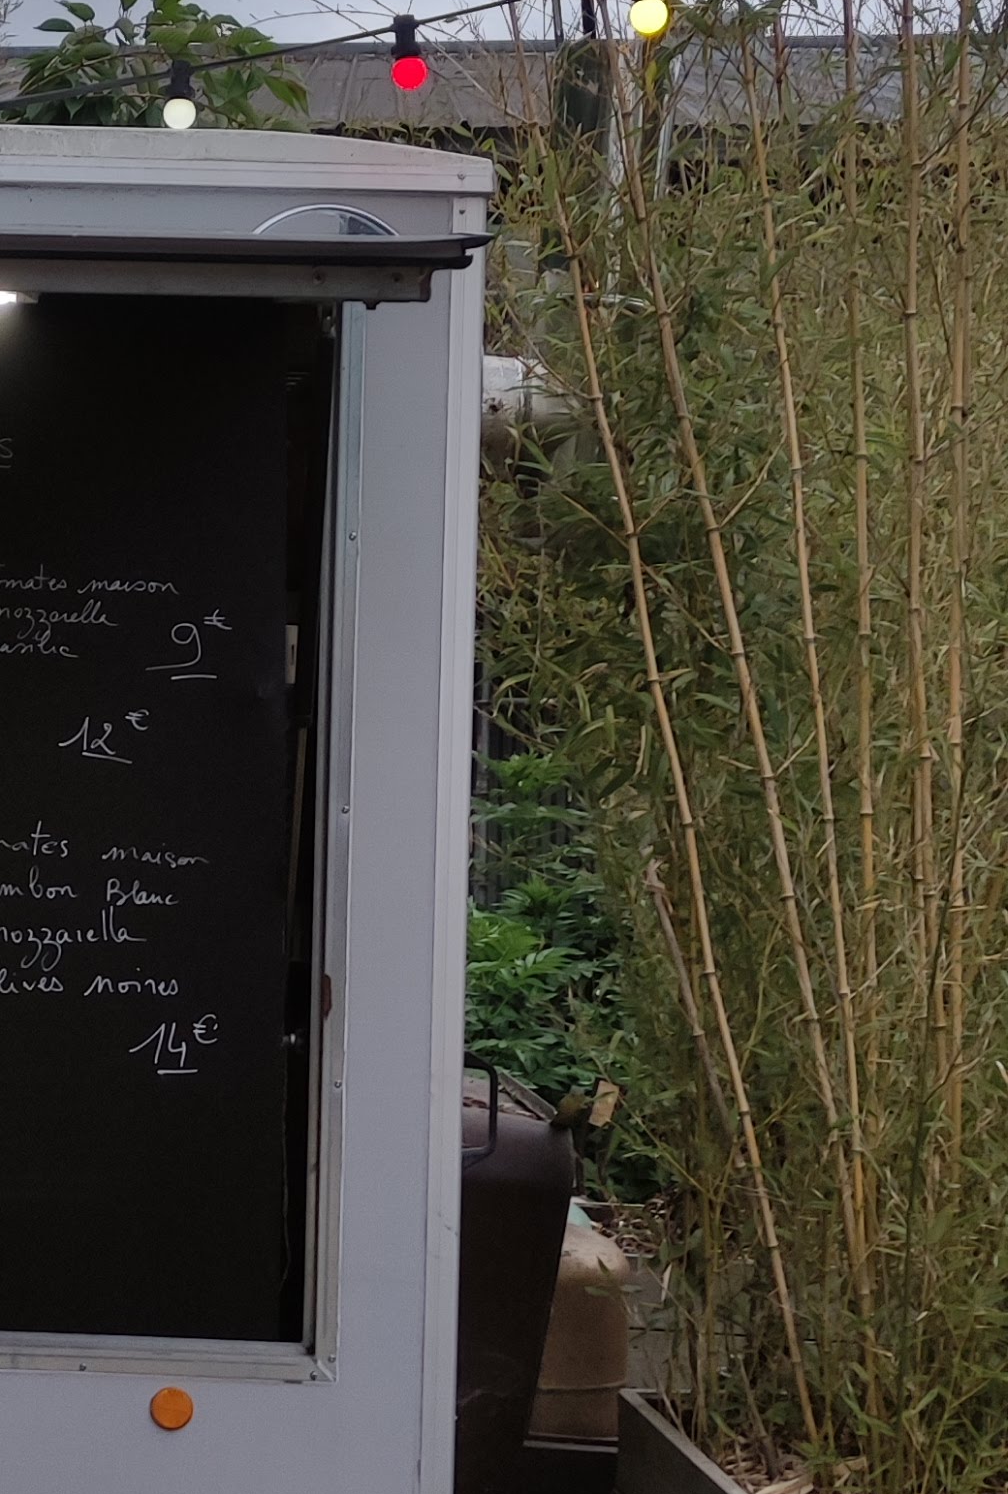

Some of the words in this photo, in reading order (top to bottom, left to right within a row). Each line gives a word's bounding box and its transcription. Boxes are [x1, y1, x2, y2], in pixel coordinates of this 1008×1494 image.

[101, 844, 209, 865] maison
[105, 879, 179, 907] Blanc
[84, 967, 180, 996] noires
